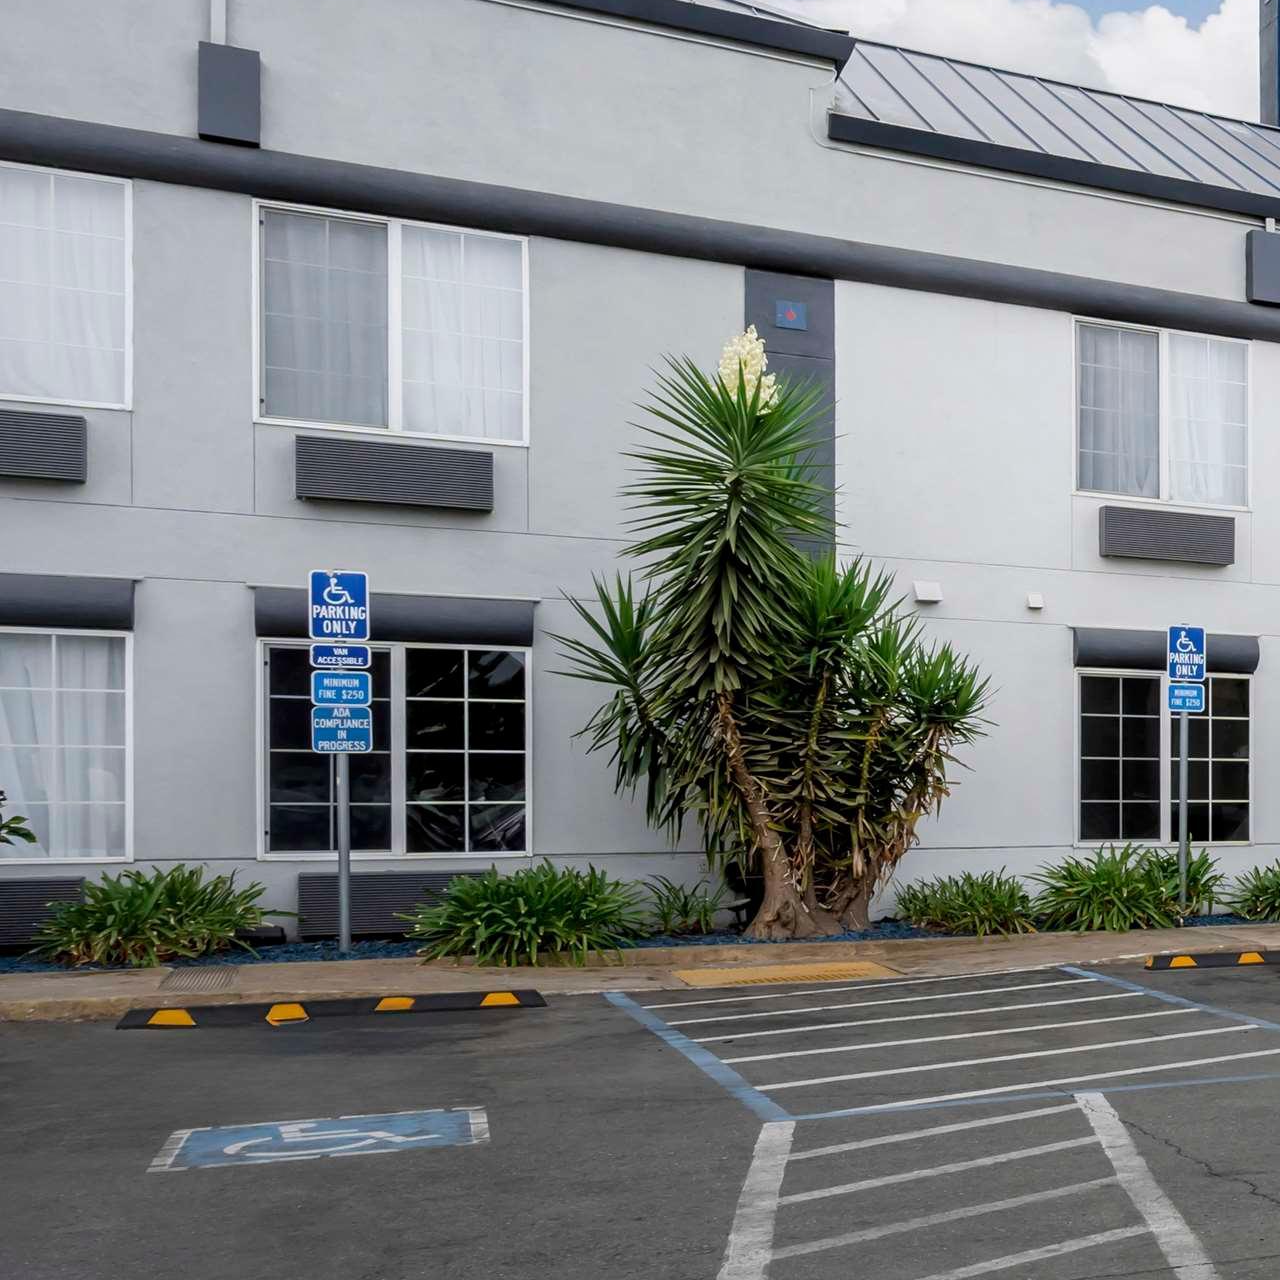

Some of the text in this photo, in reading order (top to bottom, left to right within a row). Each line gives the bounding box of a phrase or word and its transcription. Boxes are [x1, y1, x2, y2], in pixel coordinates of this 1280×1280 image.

[313, 605, 366, 620] PARKING
[323, 620, 357, 634] ONLY
[333, 648, 348, 656] VAN
[317, 656, 364, 665] ACCESSIBLE
[1170, 652, 1204, 664] PARKING
[1176, 665, 1198, 676] ONLY
[323, 678, 360, 688] MINIMUM
[318, 689, 365, 700] FINE $250
[332, 708, 351, 718] ADA
[314, 719, 370, 729] COMPLIANCE
[337, 730, 347, 740] IN
[318, 740, 366, 751] PROGRESS
